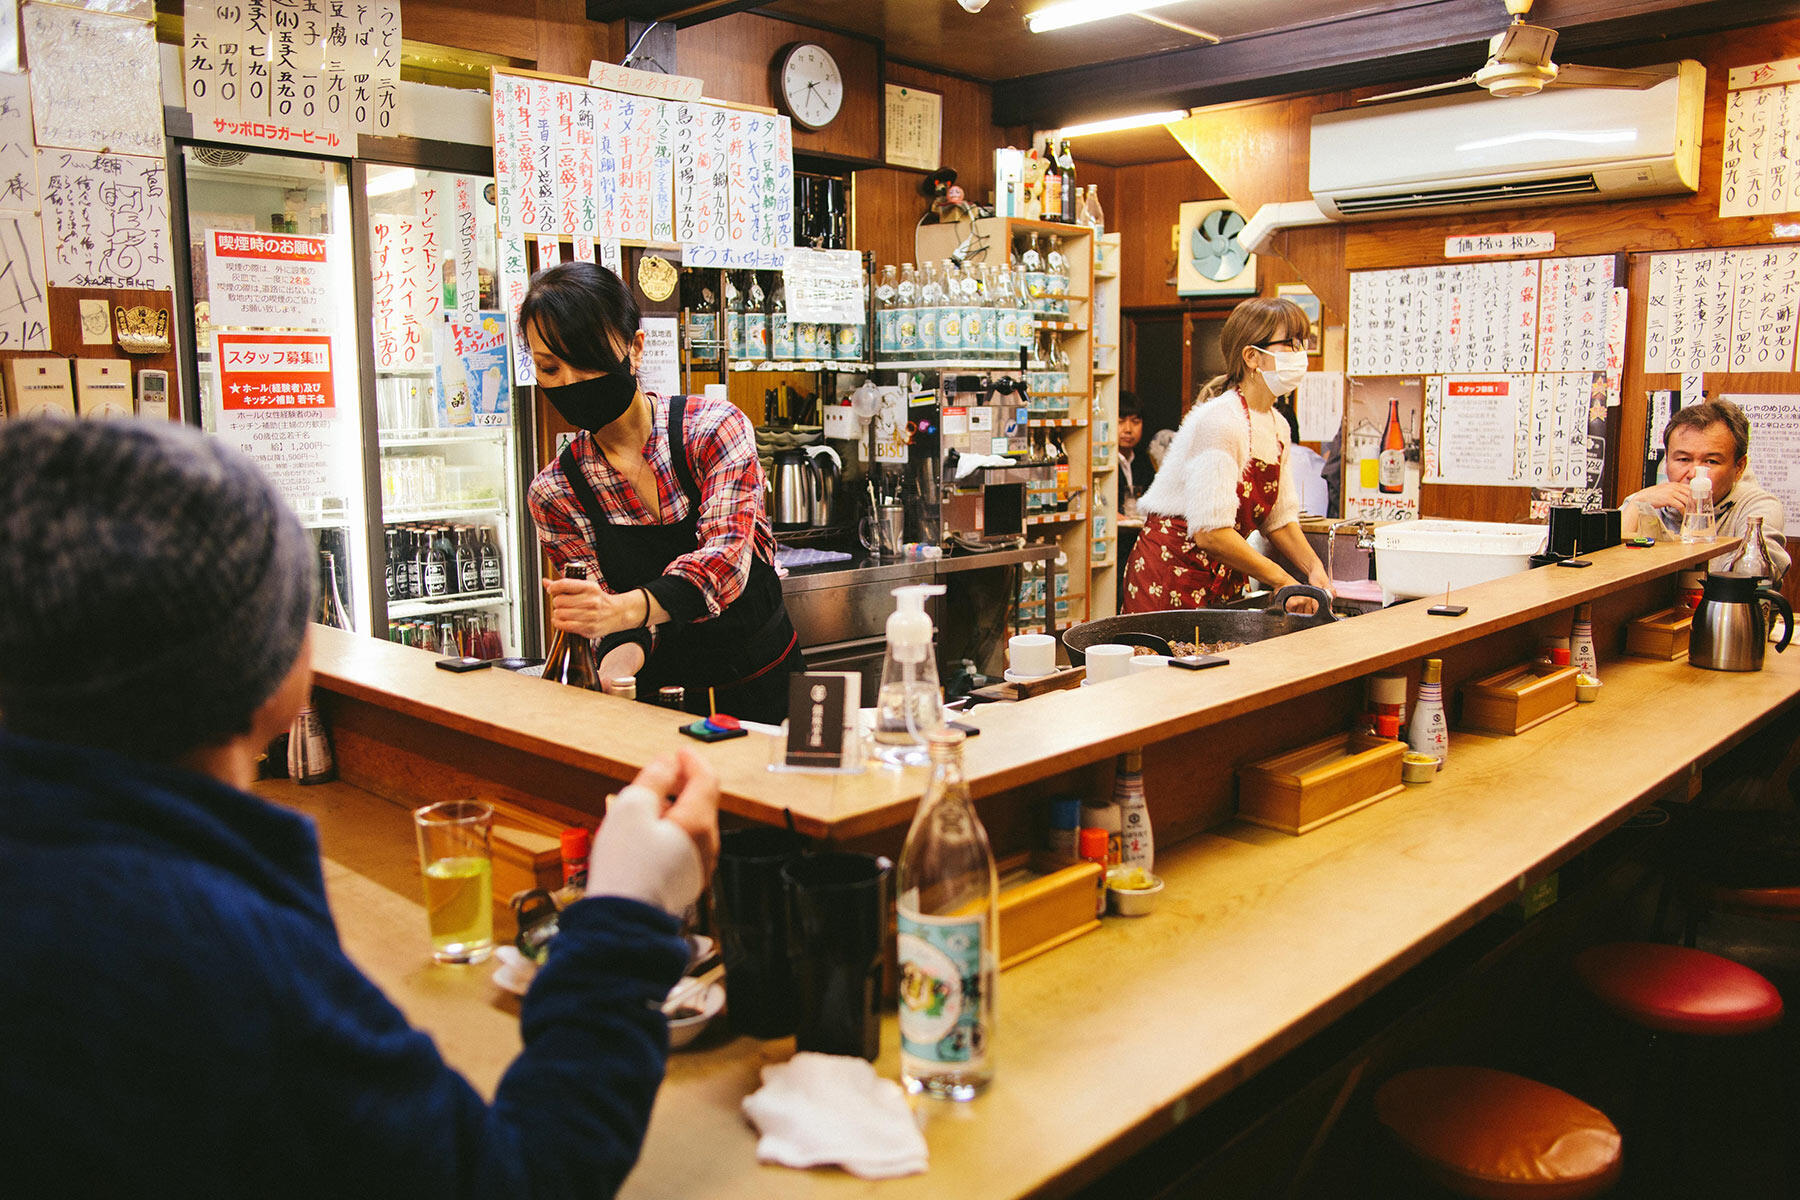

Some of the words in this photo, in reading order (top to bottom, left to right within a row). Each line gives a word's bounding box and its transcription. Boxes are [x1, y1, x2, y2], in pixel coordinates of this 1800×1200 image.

[213, 117, 341, 149] サッポロラガービール
[218, 235, 326, 255] 喫煙時のお願い
[421, 189, 440, 318] サービスドリンク
[451, 323, 484, 340] レモン
[862, 441, 905, 459] YBISU
